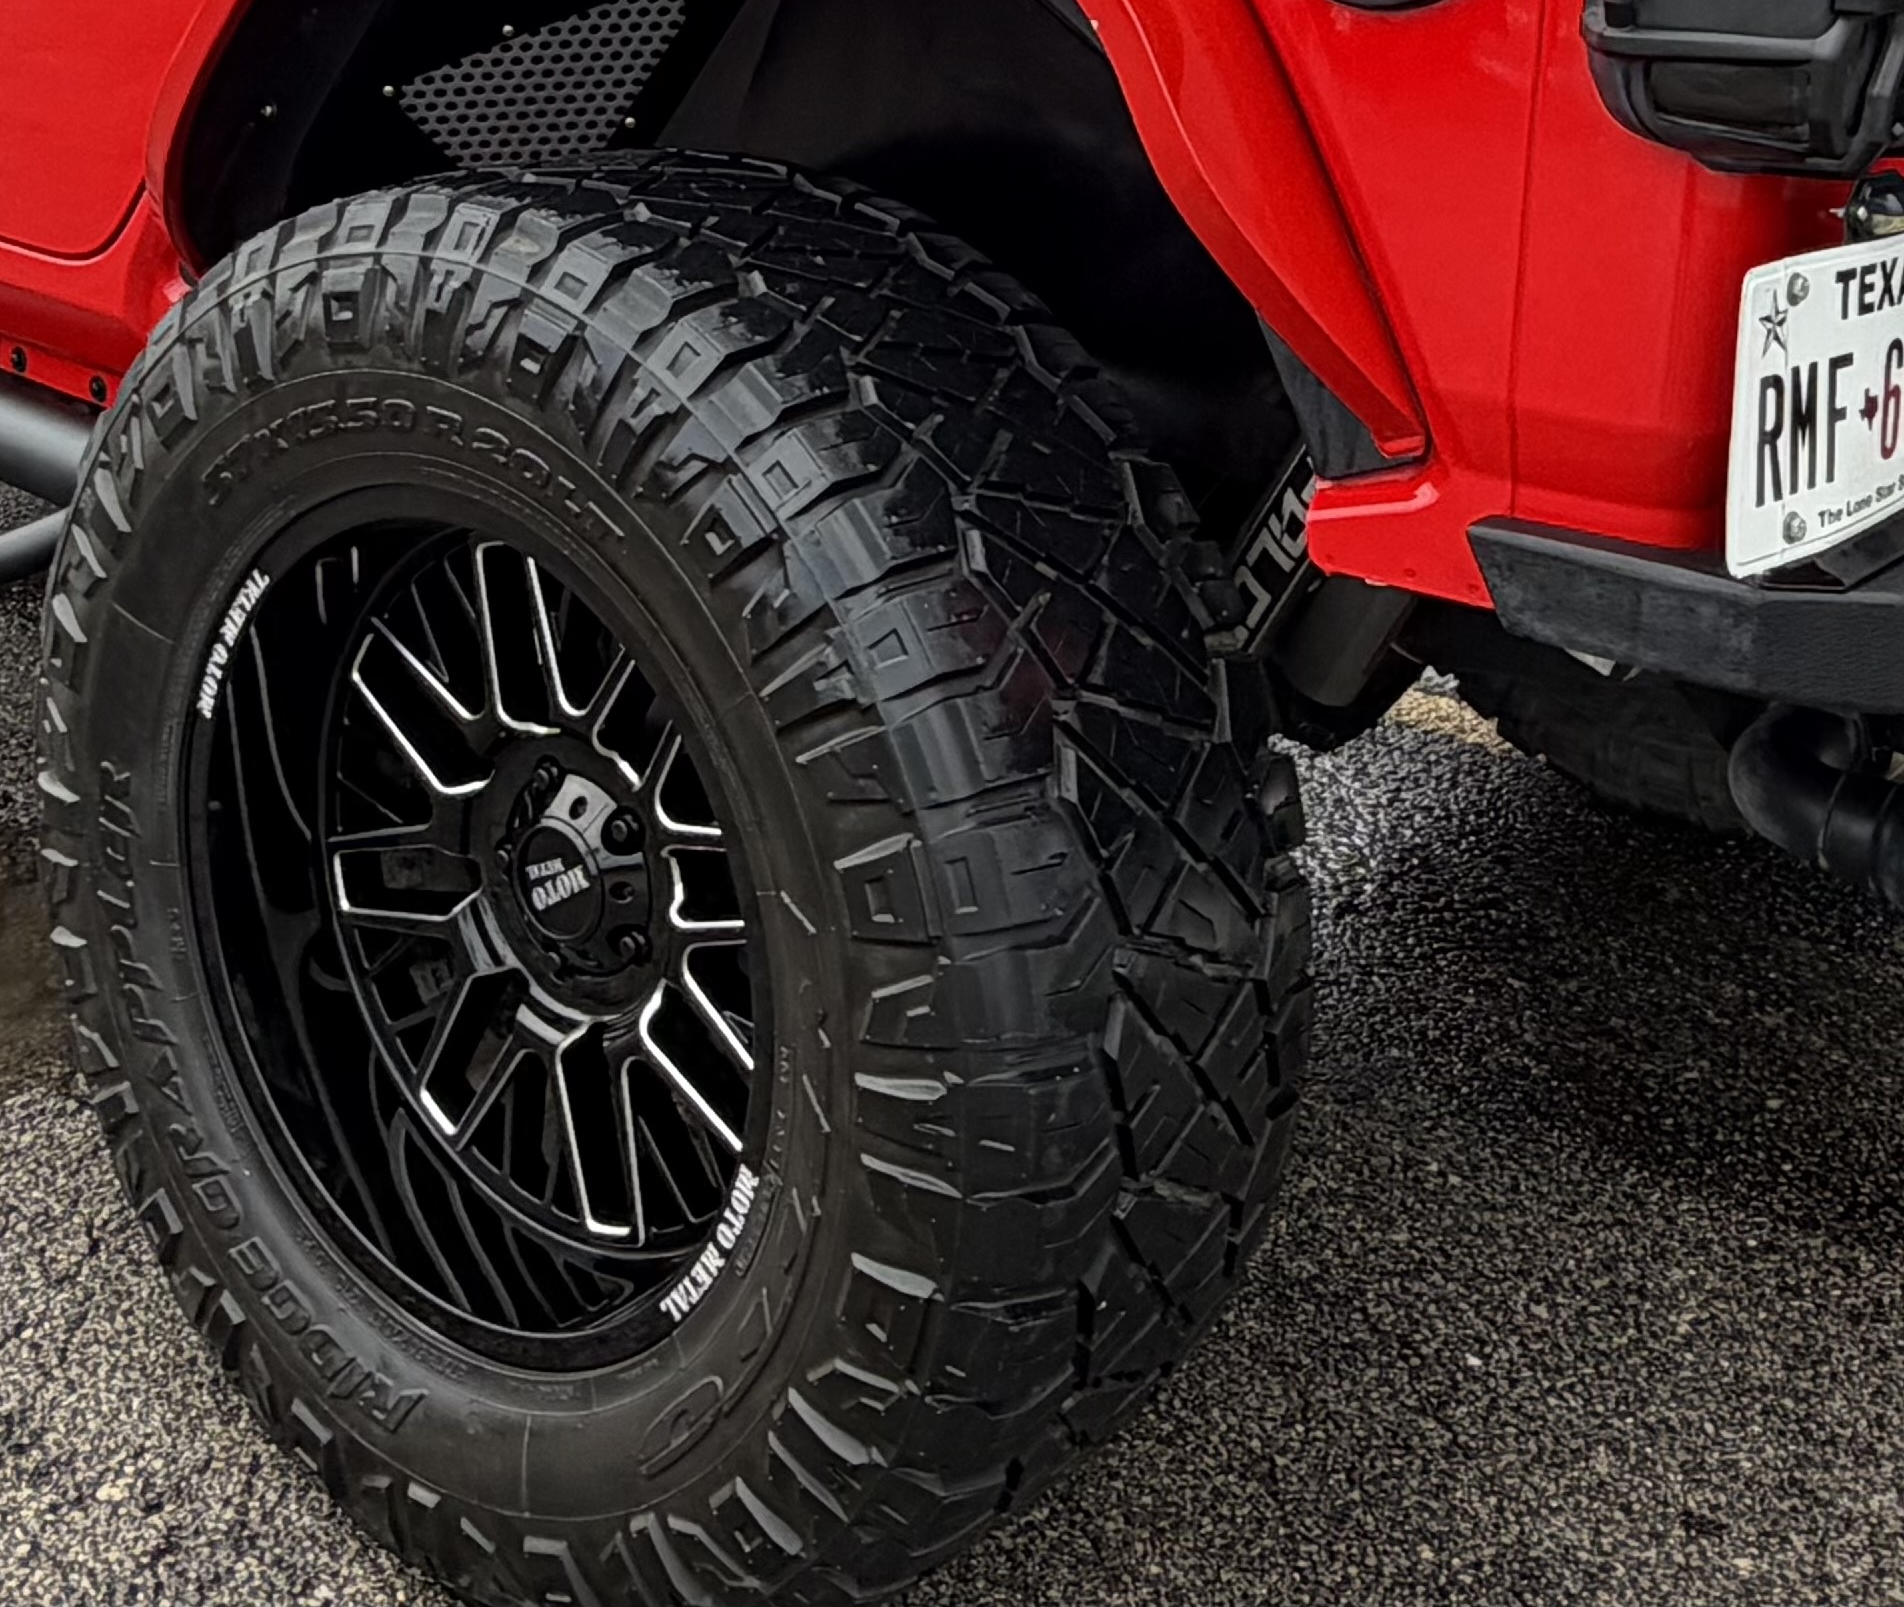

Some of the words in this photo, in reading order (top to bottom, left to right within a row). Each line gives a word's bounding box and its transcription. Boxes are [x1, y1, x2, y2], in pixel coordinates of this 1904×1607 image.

[1755, 352, 1854, 507] RMF
[1818, 508, 1843, 528] The
[1846, 494, 1872, 517] Lone
[1876, 482, 1896, 502] Star
[196, 642, 228, 719] MOTO
[219, 568, 270, 647] METAL
[531, 864, 591, 911] MOTO
[716, 1162, 760, 1250] MOTO
[658, 1241, 726, 1322] METAL
